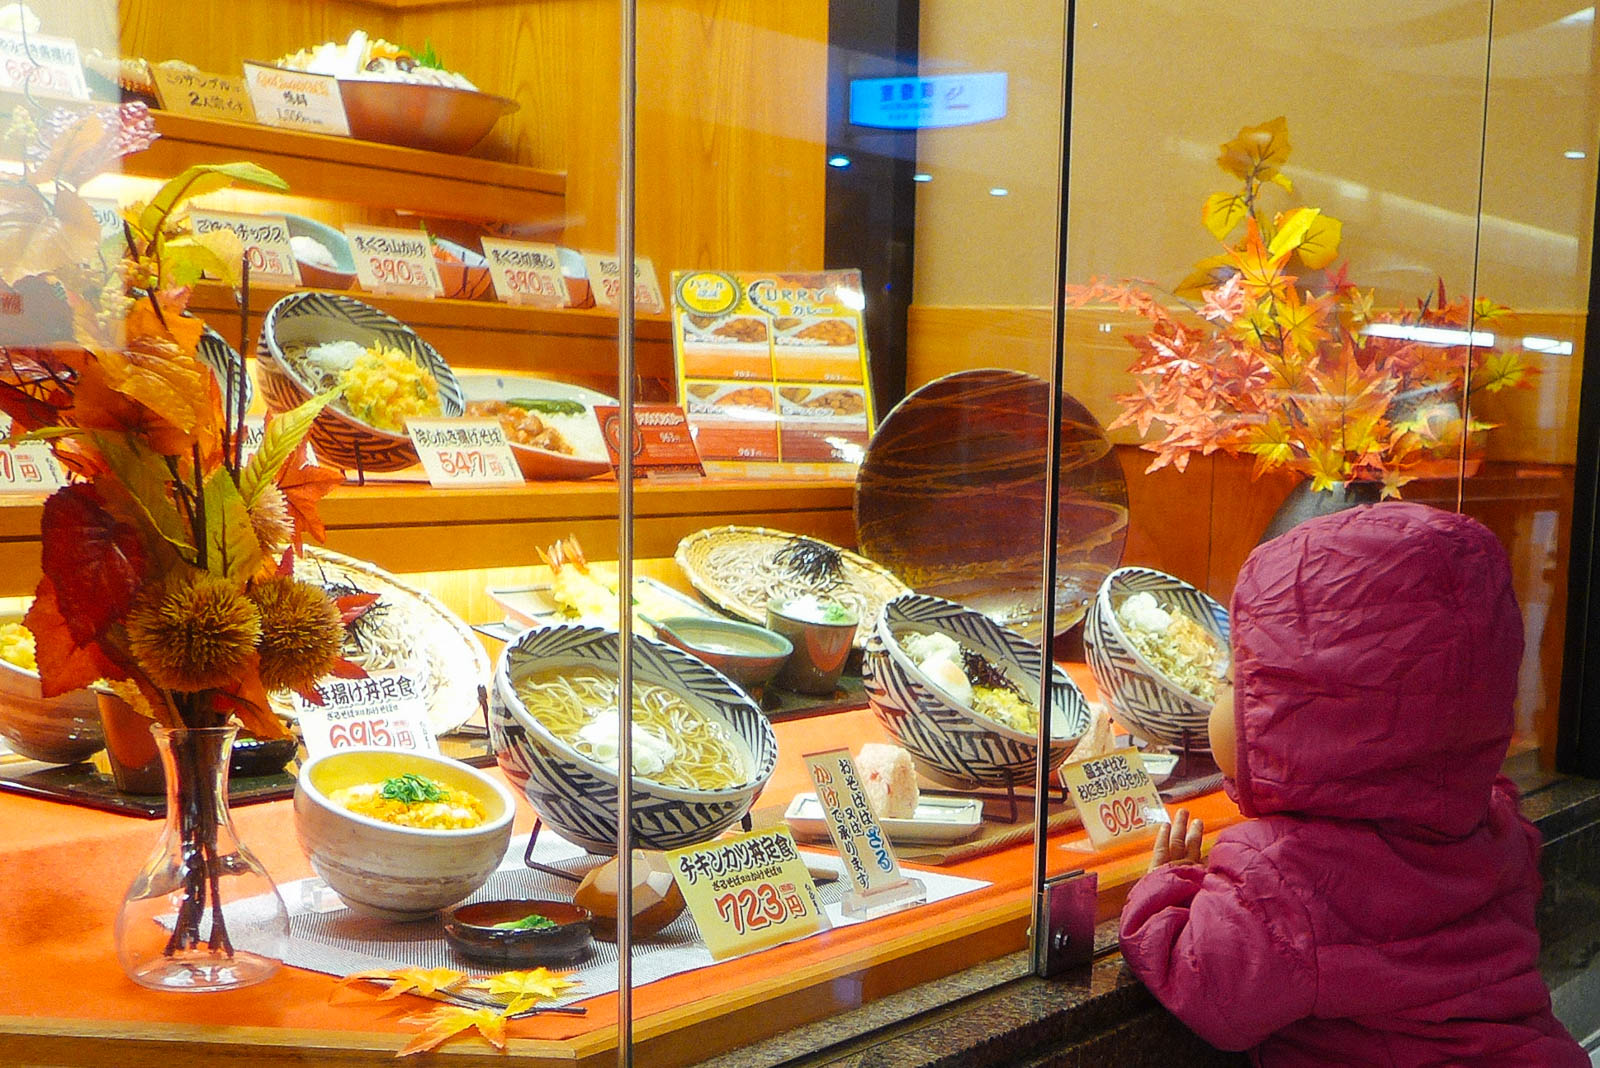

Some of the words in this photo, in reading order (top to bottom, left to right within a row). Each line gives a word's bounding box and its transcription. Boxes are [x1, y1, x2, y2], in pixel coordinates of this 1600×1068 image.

[748, 279, 828, 317] CURRY
[792, 304, 833, 317] カレー
[301, 675, 416, 708] き揚げ丼定食
[680, 833, 796, 884] チキンカツ丼定食
